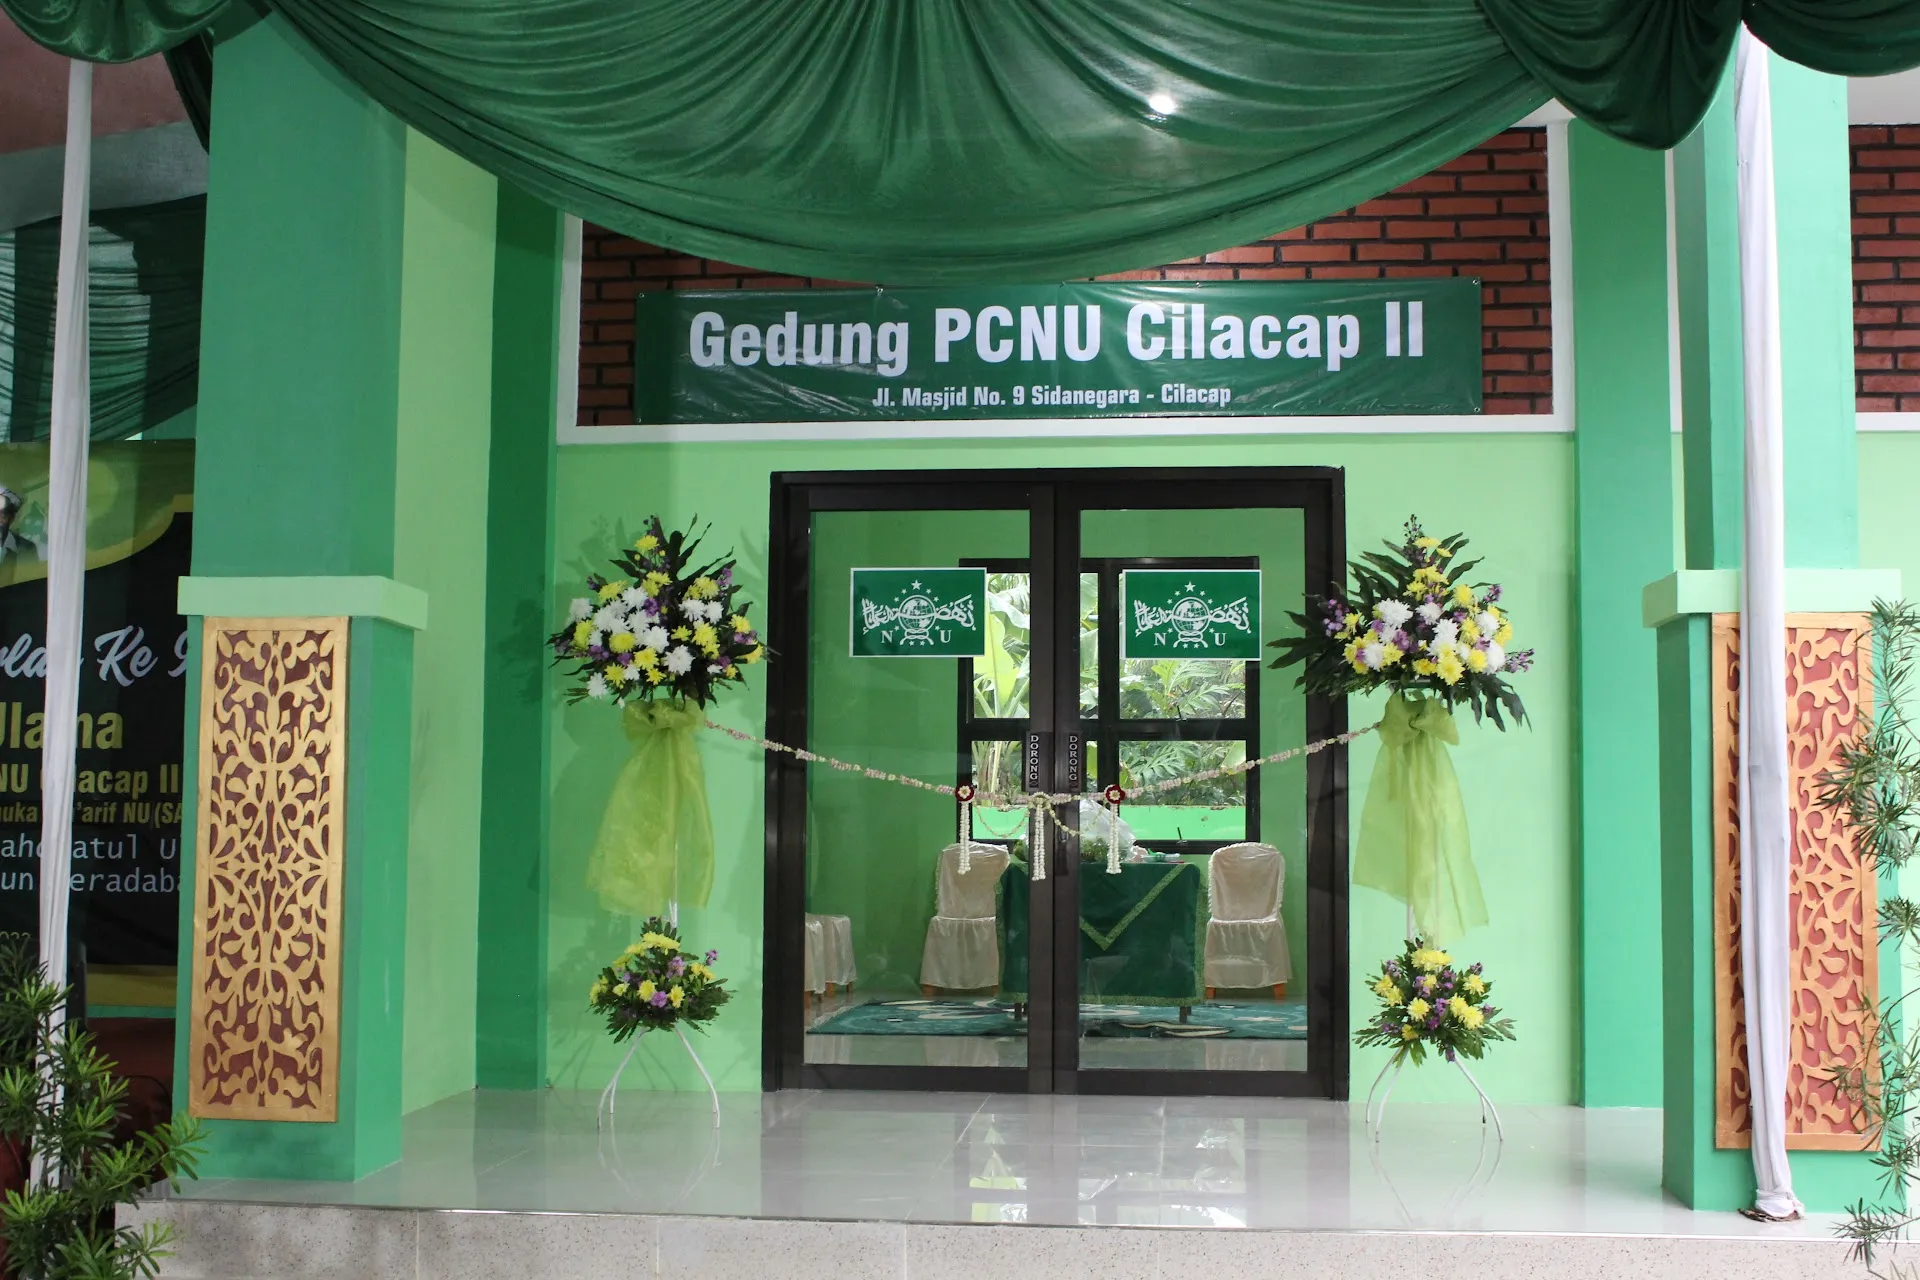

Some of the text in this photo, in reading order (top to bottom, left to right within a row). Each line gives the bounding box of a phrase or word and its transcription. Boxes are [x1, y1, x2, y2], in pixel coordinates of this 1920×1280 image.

[690, 297, 1425, 378] Gedung PCNU Cilacap II
[872, 387, 896, 407] Jl.
[902, 386, 968, 411] Masjid
[973, 386, 1006, 406] No.
[1012, 385, 1026, 406] 9
[1031, 385, 1140, 409] Sidanegara
[1161, 383, 1232, 408] Cilacap
[881, 629, 952, 643] N U
[1153, 632, 1227, 646] N U
[94, 625, 158, 687] Ke
[1029, 734, 1039, 780] DORONG
[1068, 735, 1078, 781] DORONG
[123, 802, 150, 824] NU
